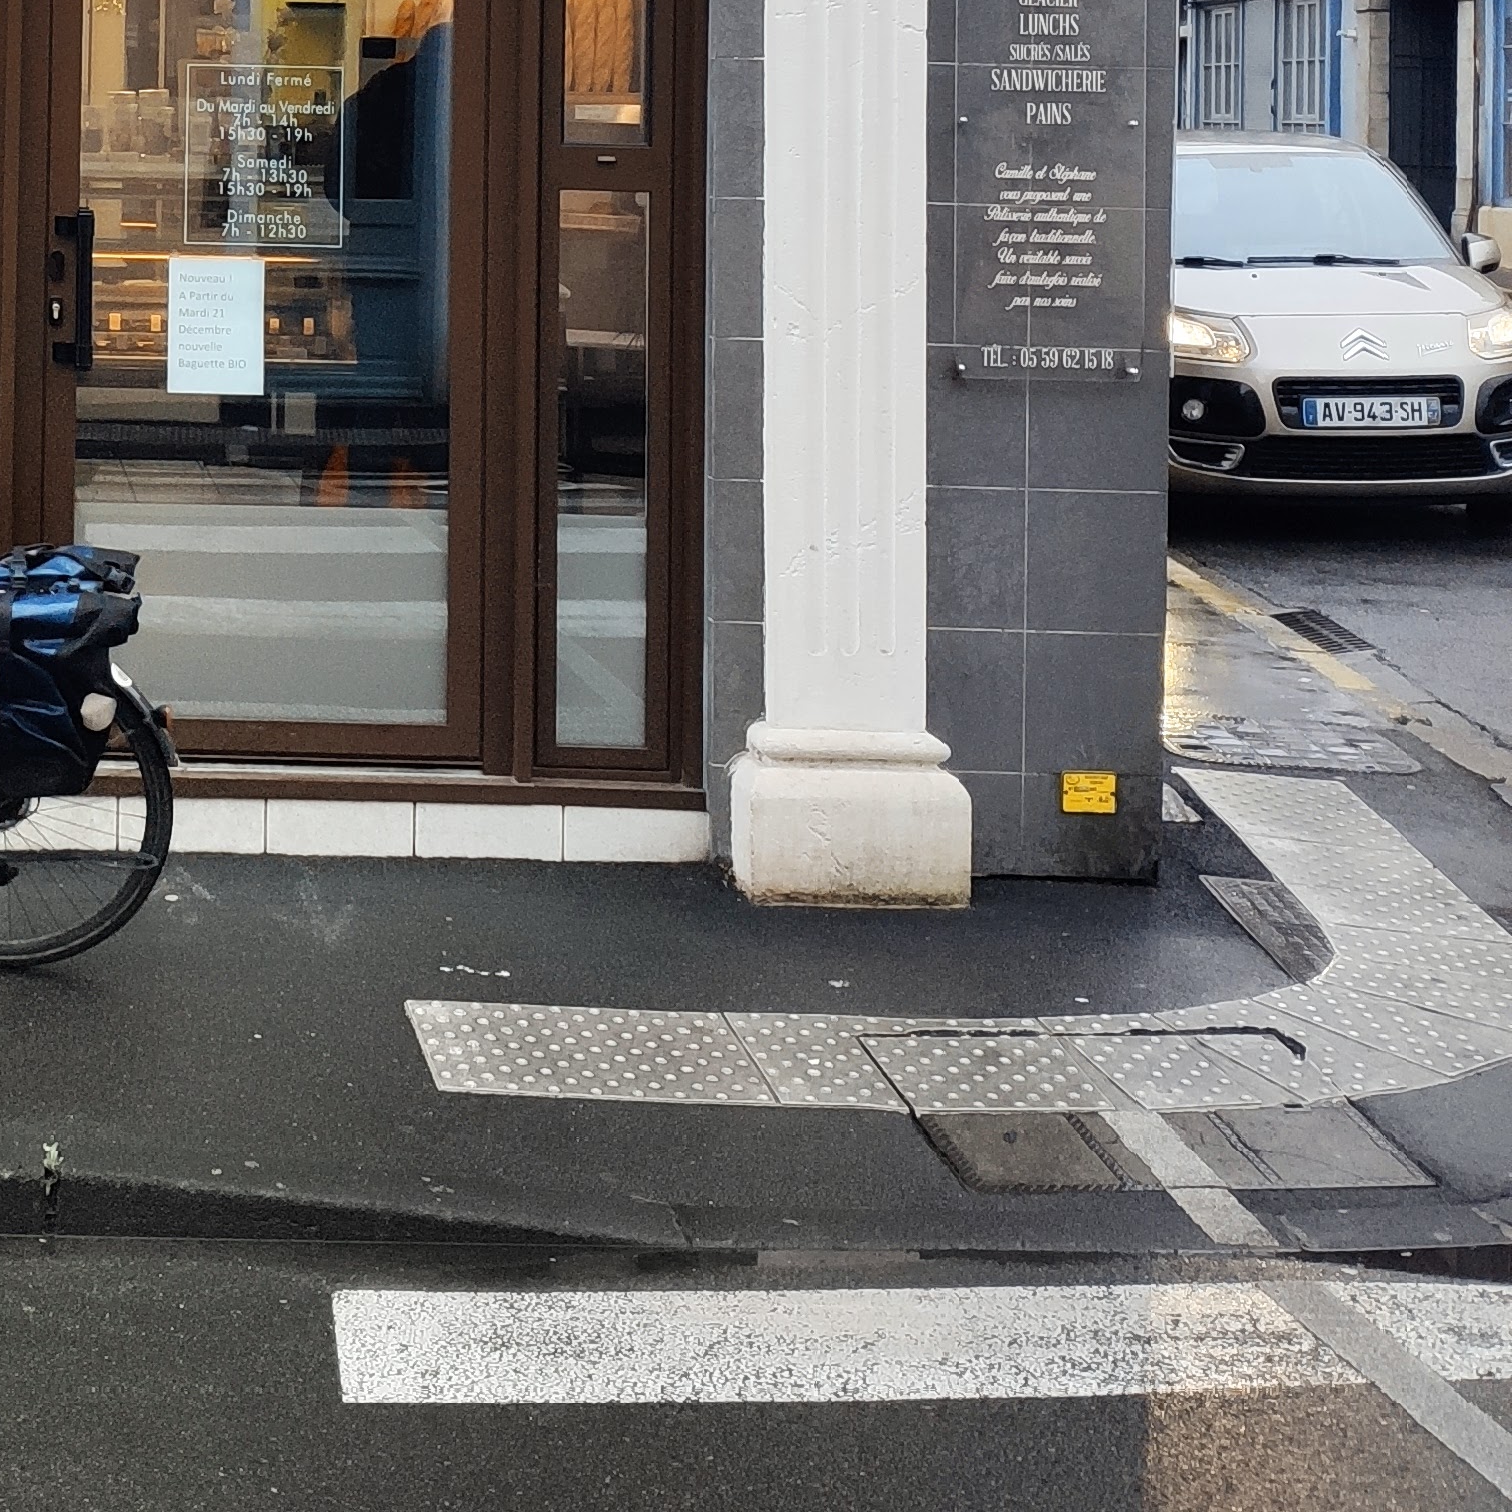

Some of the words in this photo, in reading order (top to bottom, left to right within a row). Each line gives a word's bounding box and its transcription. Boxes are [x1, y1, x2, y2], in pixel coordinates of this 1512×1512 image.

[1019, 13, 1080, 35] LUNCHS
[220, 71, 262, 86] Lundi
[267, 72, 312, 87] Fermé
[990, 69, 1107, 92] SANDWICHERIE
[196, 99, 215, 113] Du
[218, 99, 256, 114] Mardi
[259, 102, 276, 114] au
[279, 100, 335, 116] Vendredi
[1026, 103, 1072, 125] PAINS
[233, 114, 251, 128] 7h
[270, 114, 298, 128] 14h
[219, 127, 265, 142] 15h30
[286, 128, 313, 143] 19h
[237, 154, 292, 169] Samedi
[222, 168, 239, 182] 7h
[260, 169, 308, 184] 13h30
[994, 162, 1033, 180] Camille
[1035, 165, 1046, 180] et
[1049, 163, 1096, 185] Stéphane
[218, 182, 265, 197] 15h30
[285, 183, 313, 198] 19h
[999, 190, 1021, 201] vous
[1016, 187, 1071, 205] proposent
[1072, 191, 1092, 202] une
[227, 210, 301, 225] Dimanche
[1033, 208, 1091, 227] authentique
[1093, 208, 1107, 223] de
[222, 223, 240, 237] 7h
[259, 223, 307, 239] 12h30
[992, 228, 1027, 246] façon
[997, 247, 1016, 264] Un
[1019, 250, 1061, 265] véritable
[1062, 252, 1093, 265] savoir
[179, 273, 226, 284] Nouveau
[988, 270, 1017, 289] faire
[1069, 273, 1104, 287] réalisé
[190, 291, 218, 302] Partir
[221, 291, 234, 302] du
[1005, 296, 1030, 310] par
[1033, 296, 1051, 307] nos
[1051, 294, 1077, 307] soins
[179, 308, 210, 319] Mardi
[212, 308, 225, 319] 21
[178, 324, 232, 336] Décembre
[178, 341, 223, 352] nouvelle
[178, 358, 226, 372] Baguette
[228, 359, 247, 369] BIO
[1020, 348, 1037, 368] 05
[1040, 349, 1059, 369] 59
[1062, 349, 1080, 369] 62
[1084, 349, 1097, 369] 15
[1101, 349, 1114, 370] 18
[1321, 400, 1423, 423] AV-943-SH
